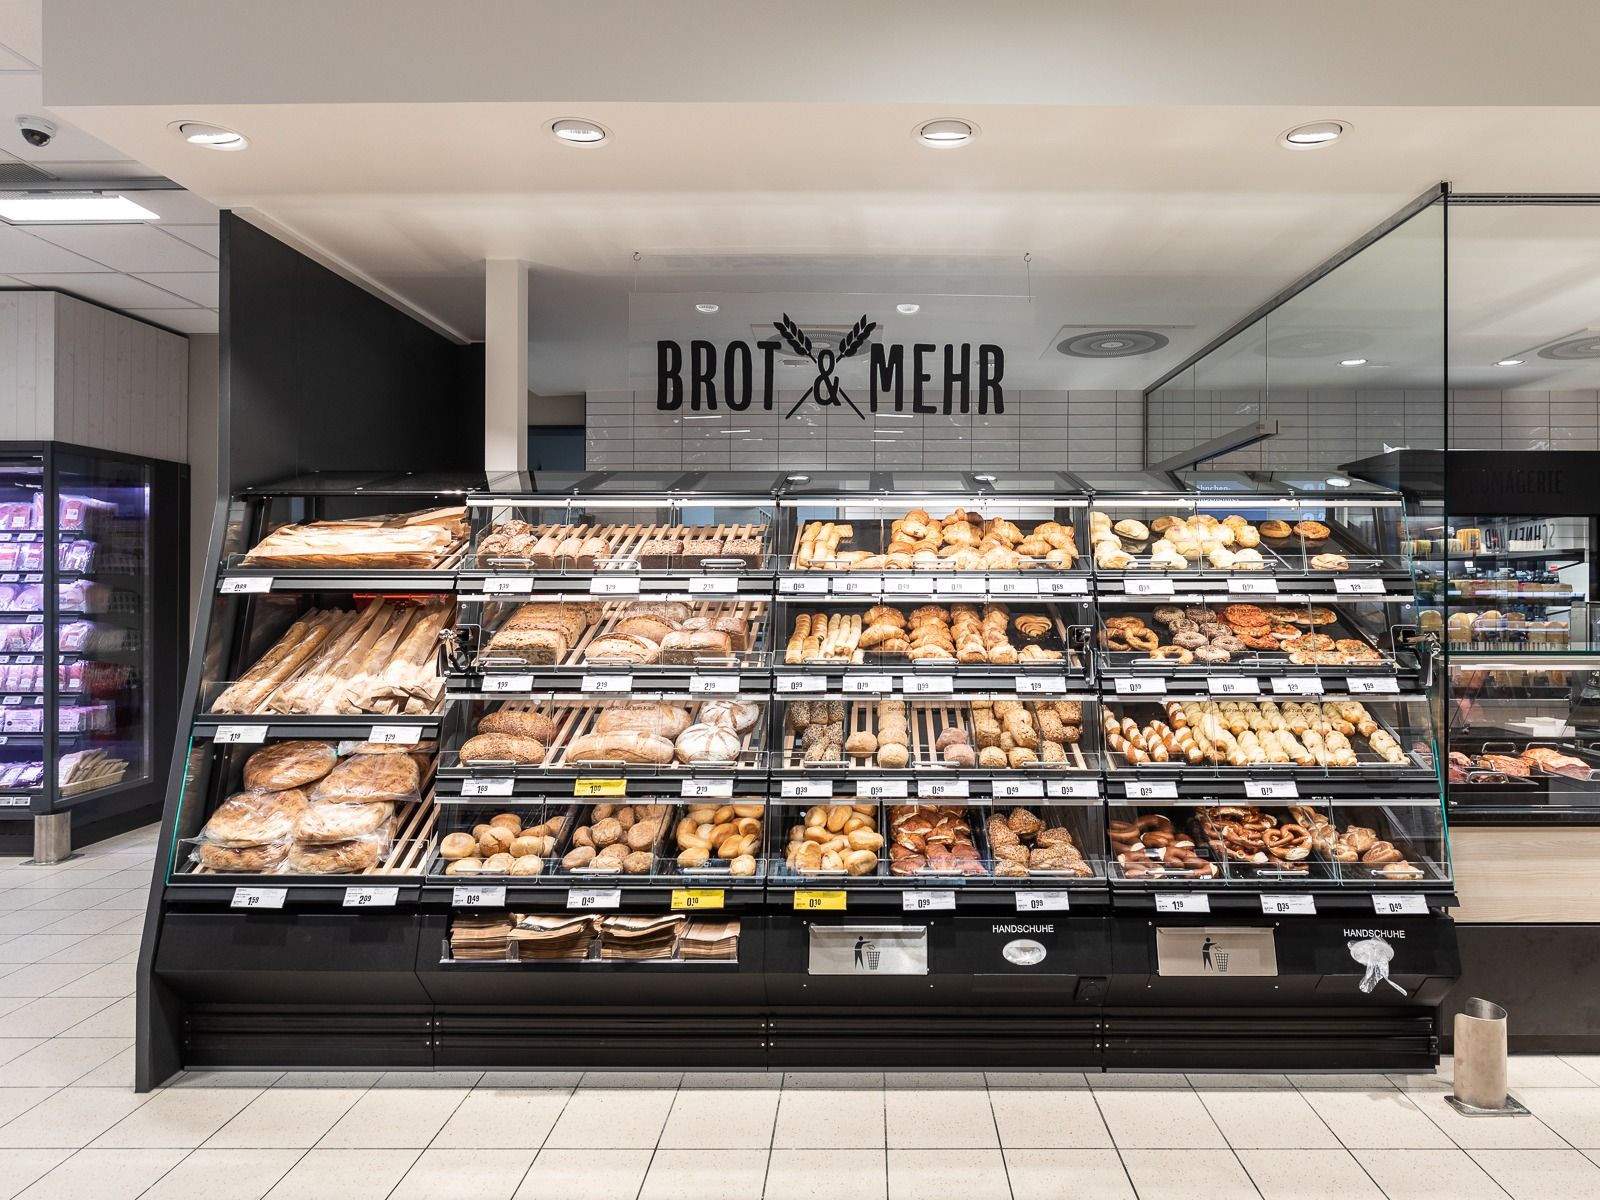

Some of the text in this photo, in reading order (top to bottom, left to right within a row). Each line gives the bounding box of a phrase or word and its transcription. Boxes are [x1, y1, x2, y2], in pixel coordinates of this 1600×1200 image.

[657, 340, 1005, 415] BROT & MEHR
[1465, 469, 1564, 495] OMAGERIE
[871, 787, 882, 795] 0.59
[932, 786, 944, 794] 0.49
[1007, 787, 1018, 795] 0.49
[247, 896, 260, 905] 1.59
[359, 895, 372, 904] 2.09
[467, 895, 480, 904] 0.49
[582, 897, 595, 906] 0.49
[686, 897, 698, 906] 0.10
[809, 899, 821, 907] 0.10
[918, 899, 930, 908] 0.99
[1031, 900, 1044, 909] 0.99
[1277, 903, 1289, 912] 0.35
[1389, 903, 1402, 912] 0.49
[992, 924, 1055, 934] HANDSCHUHE
[1343, 928, 1406, 939] HANDSCHUHE
